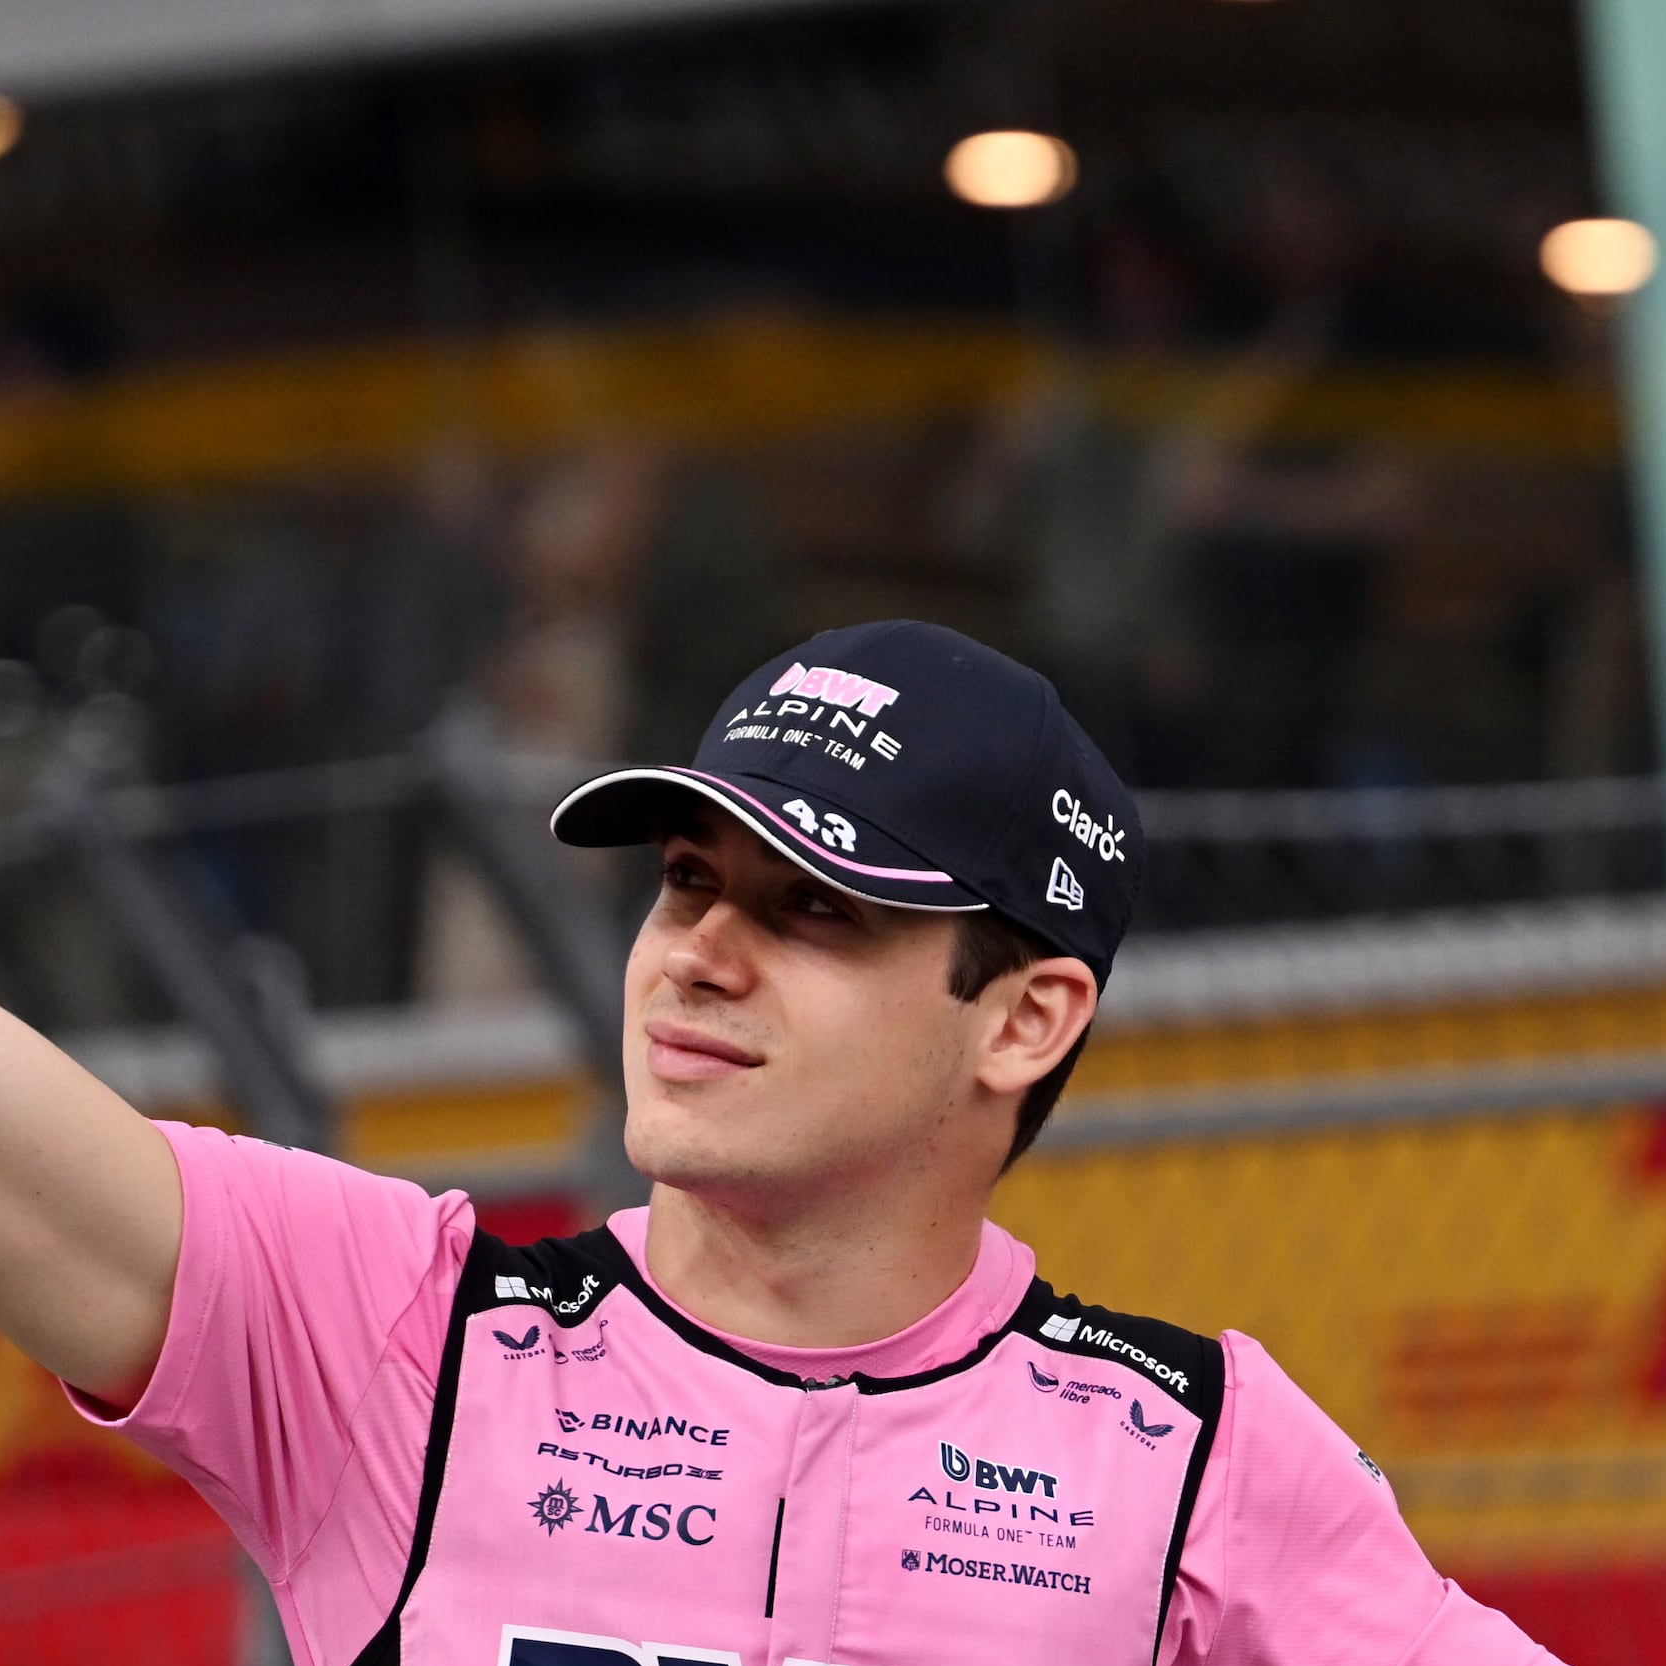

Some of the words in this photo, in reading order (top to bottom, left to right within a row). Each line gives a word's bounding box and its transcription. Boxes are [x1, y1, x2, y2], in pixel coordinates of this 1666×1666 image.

[790, 666, 901, 719] BWT
[724, 724, 779, 743] FORMULA
[824, 739, 867, 771] TEAM
[726, 699, 903, 761] ALPINE
[782, 799, 857, 853] 43
[1052, 788, 1125, 862] Claro
[1079, 1325, 1190, 1394] Microsoft
[1059, 1388, 1090, 1404] libre
[1066, 1379, 1122, 1400] mercado
[591, 1413, 730, 1446] BINANCE
[1120, 1420, 1157, 1451] CASTORE
[973, 1456, 1059, 1499] BWT
[584, 1494, 717, 1546] MSC
[908, 1486, 1095, 1527] ALPINE
[925, 1515, 990, 1539] FORMULA
[1039, 1532, 1077, 1550] TEAM
[925, 1551, 1091, 1595] MOSER.WATCH
